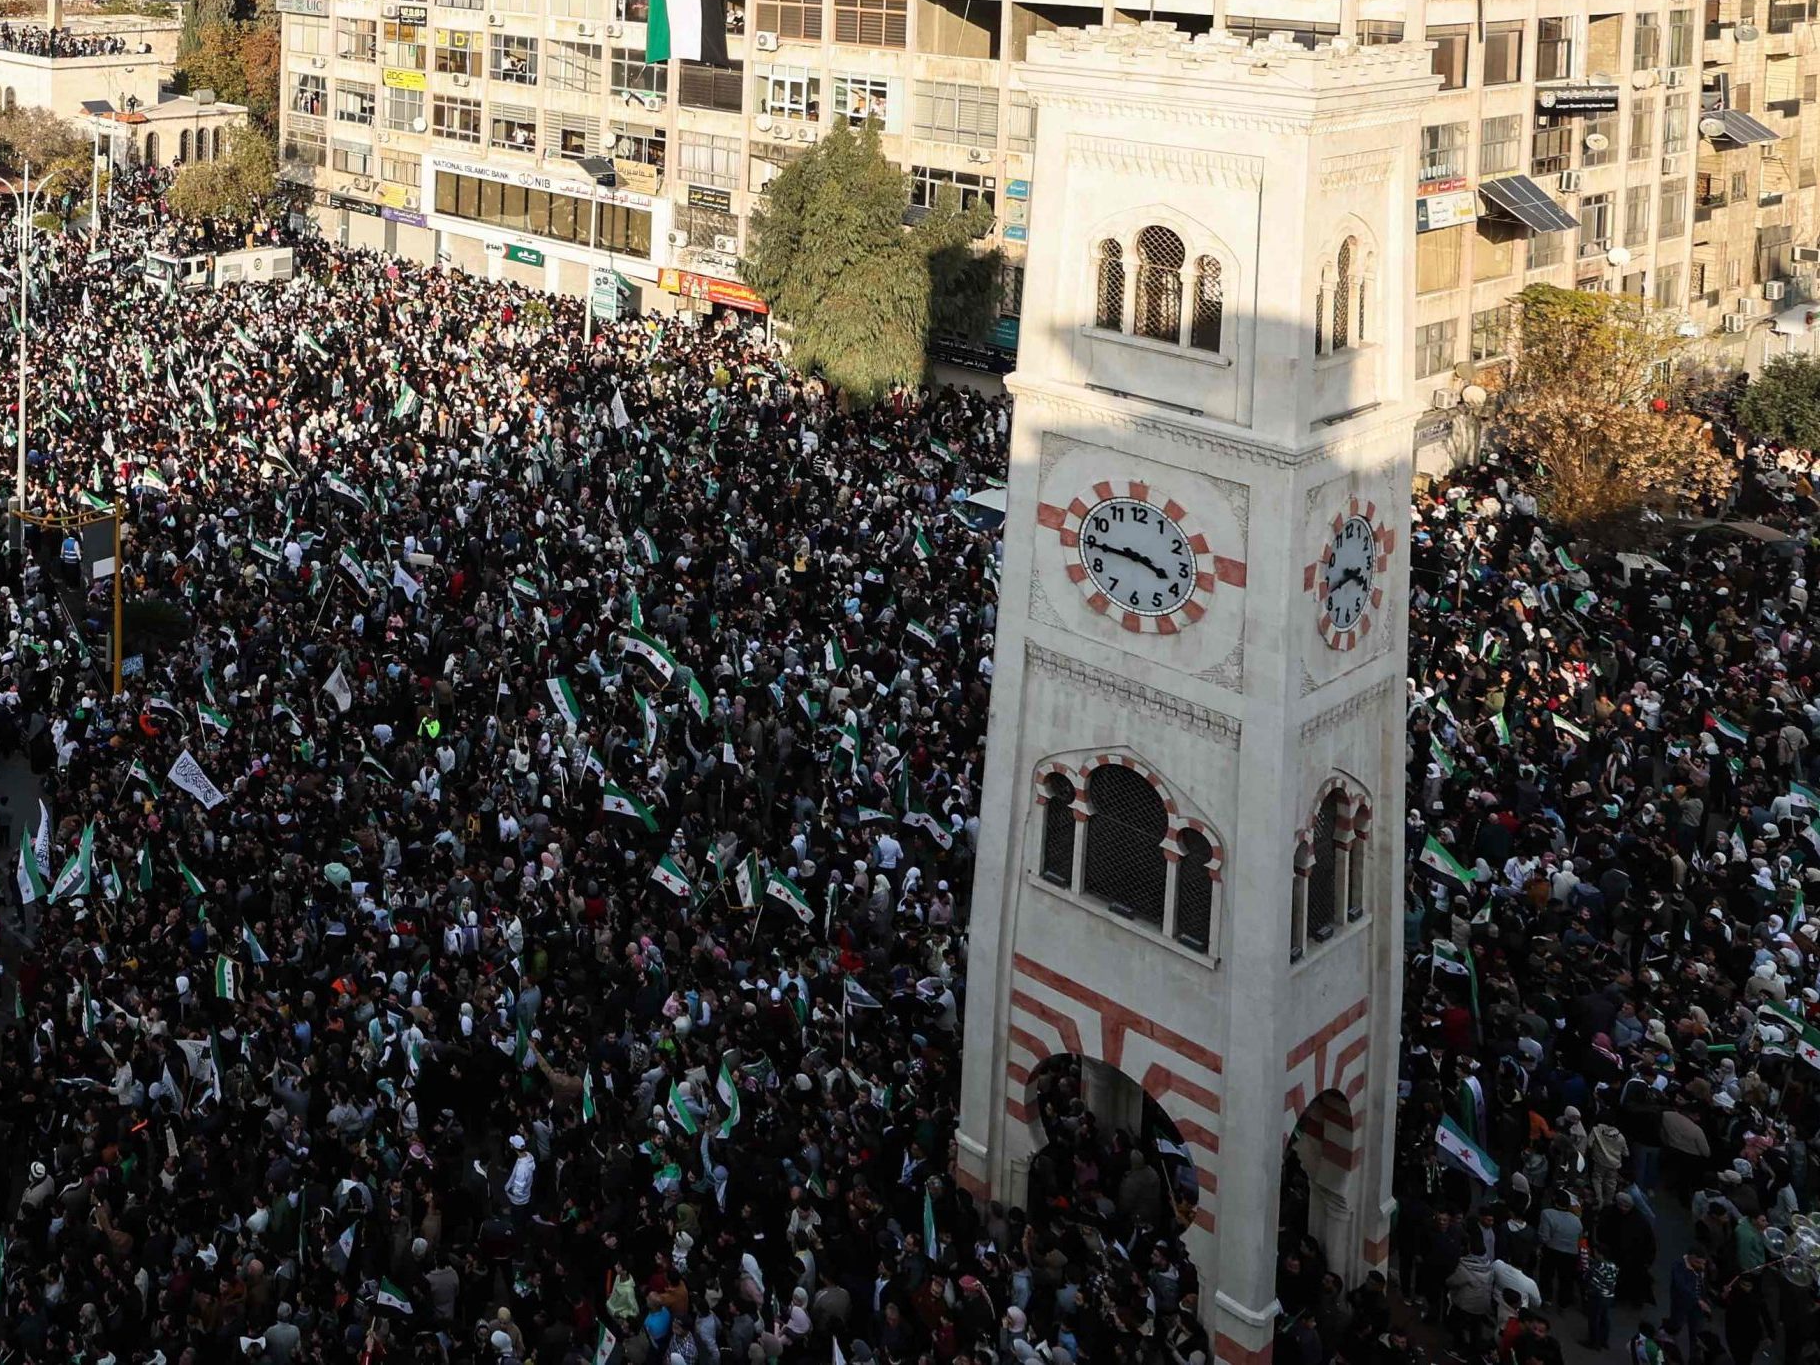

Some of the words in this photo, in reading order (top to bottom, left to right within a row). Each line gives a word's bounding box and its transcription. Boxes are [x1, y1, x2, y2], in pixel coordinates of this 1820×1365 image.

[307, 0, 323, 11] UIC
[433, 159, 463, 171] NATIONAL
[465, 165, 490, 176] ISLAMIC
[492, 170, 509, 179] BANK
[535, 177, 551, 188] NIB
[598, 193, 629, 204] الوطني
[630, 198, 652, 207] البنك
[1110, 506, 1124, 522] 11
[1131, 507, 1148, 524] 12
[1093, 517, 1109, 533] 10
[1158, 520, 1164, 534] 1
[1345, 523, 1354, 539] 12
[1357, 525, 1361, 539] 1
[1087, 535, 1096, 549] 9
[1171, 539, 1182, 555] 2
[1336, 532, 1343, 549] 11
[1363, 536, 1368, 551] 2
[1093, 558, 1103, 572] 8
[1179, 562, 1188, 578] 3
[1366, 556, 1372, 570] 3
[1109, 577, 1118, 591] 7
[1169, 583, 1180, 597] 4
[1130, 591, 1139, 605] 6
[1152, 592, 1162, 607] 5
[1327, 595, 1333, 611] 8
[1355, 597, 1360, 612] 5
[1335, 607, 1340, 622] 7
[1345, 608, 1350, 623] 6
